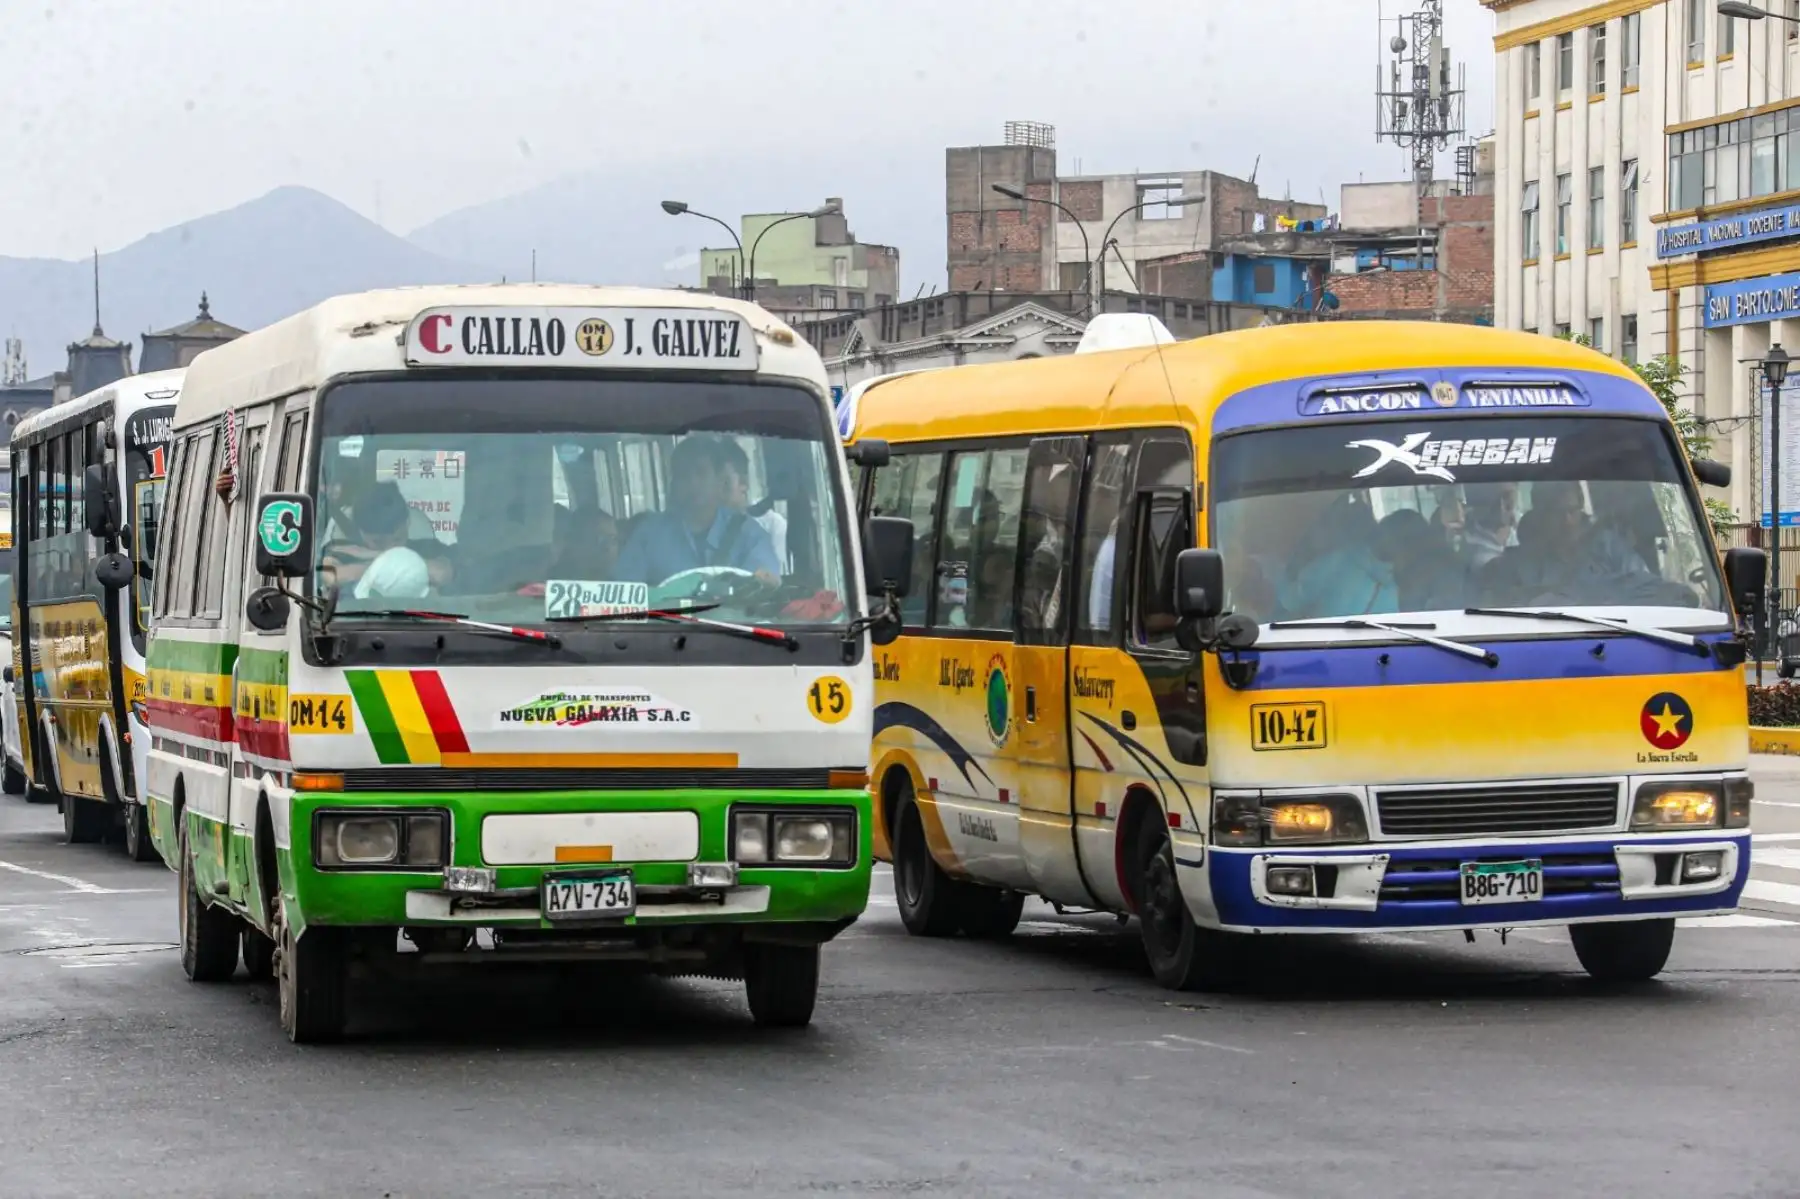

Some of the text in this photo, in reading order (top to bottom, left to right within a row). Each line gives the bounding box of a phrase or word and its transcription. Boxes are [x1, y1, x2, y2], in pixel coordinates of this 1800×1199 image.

[1669, 227, 1703, 250] HOSPITAL
[1708, 221, 1744, 243] NACIONAL
[1748, 213, 1784, 236] DOCENTE
[418, 314, 566, 357] C CALLAO
[582, 324, 606, 335] OM
[584, 335, 605, 352] 14
[624, 318, 741, 358] J. GALVEZ
[1318, 387, 1575, 414] ANCON VENTANILLA
[1345, 431, 1558, 483] XEROBAN
[548, 583, 582, 618] 28
[592, 583, 647, 605] JULIO
[540, 694, 651, 702] EMPRESA DE TRANSPORTES
[810, 682, 845, 714] 15
[500, 704, 691, 722] NUEVA GALAXIA S.A.C
[1671, 751, 1699, 763] Estrella
[549, 881, 630, 911] A7V-734
[1464, 871, 1539, 898] B8G-710
